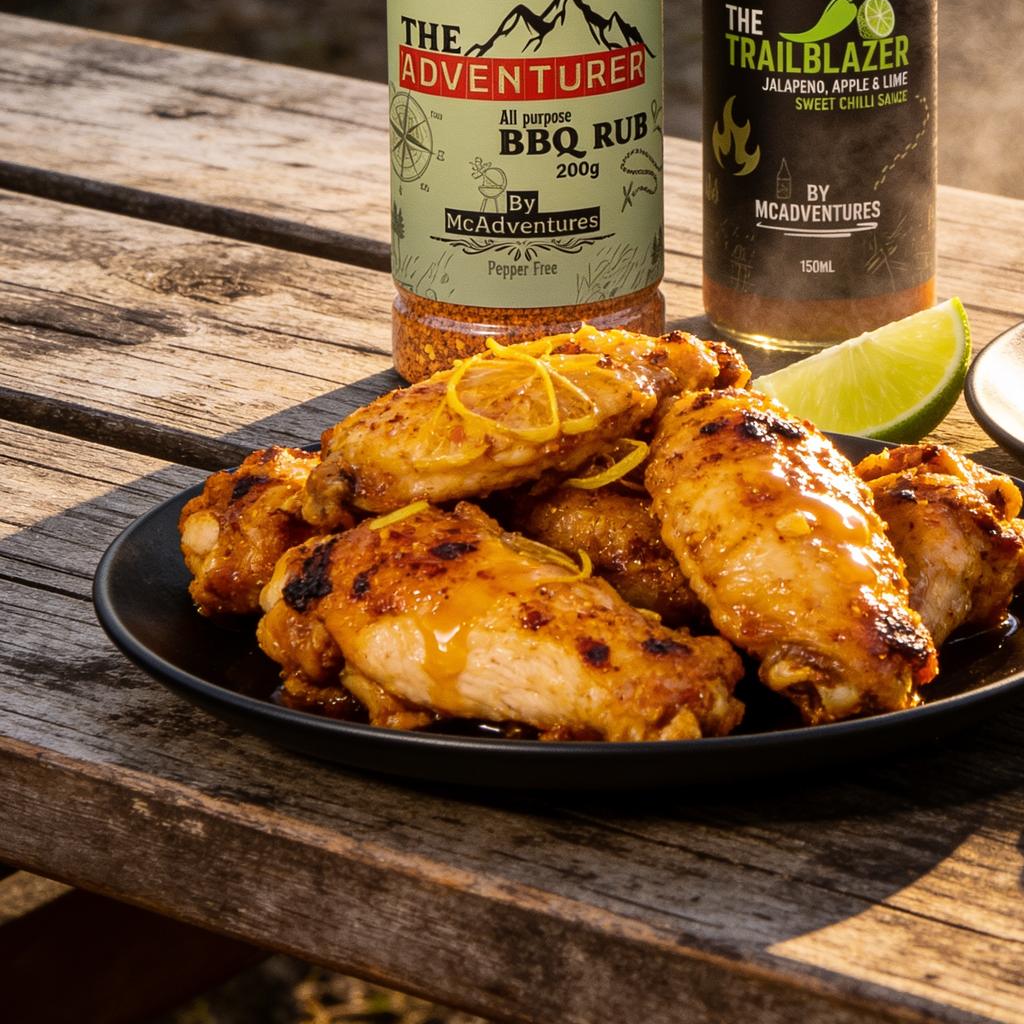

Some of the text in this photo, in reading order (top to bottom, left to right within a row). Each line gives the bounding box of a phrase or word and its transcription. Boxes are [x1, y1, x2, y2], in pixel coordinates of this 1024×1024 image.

[725, 3, 763, 36] THE
[401, 15, 462, 54] THE
[725, 34, 909, 74] TRAILBLAZER
[401, 50, 644, 94] ADVENTURER
[762, 71, 908, 95] JALAPENO, APPLE & LIME
[795, 96, 837, 111] SWEET
[839, 94, 875, 110] CHILLI
[500, 109, 572, 128] All purpose
[499, 112, 648, 159] BBQ RUB
[556, 161, 600, 179] 200g
[807, 184, 830, 202] BY
[509, 195, 536, 215] By
[755, 199, 881, 222] MCADVENTURES
[446, 212, 599, 235] McAdventures
[488, 260, 558, 280] Pepper Free
[800, 260, 835, 273] 150ML
